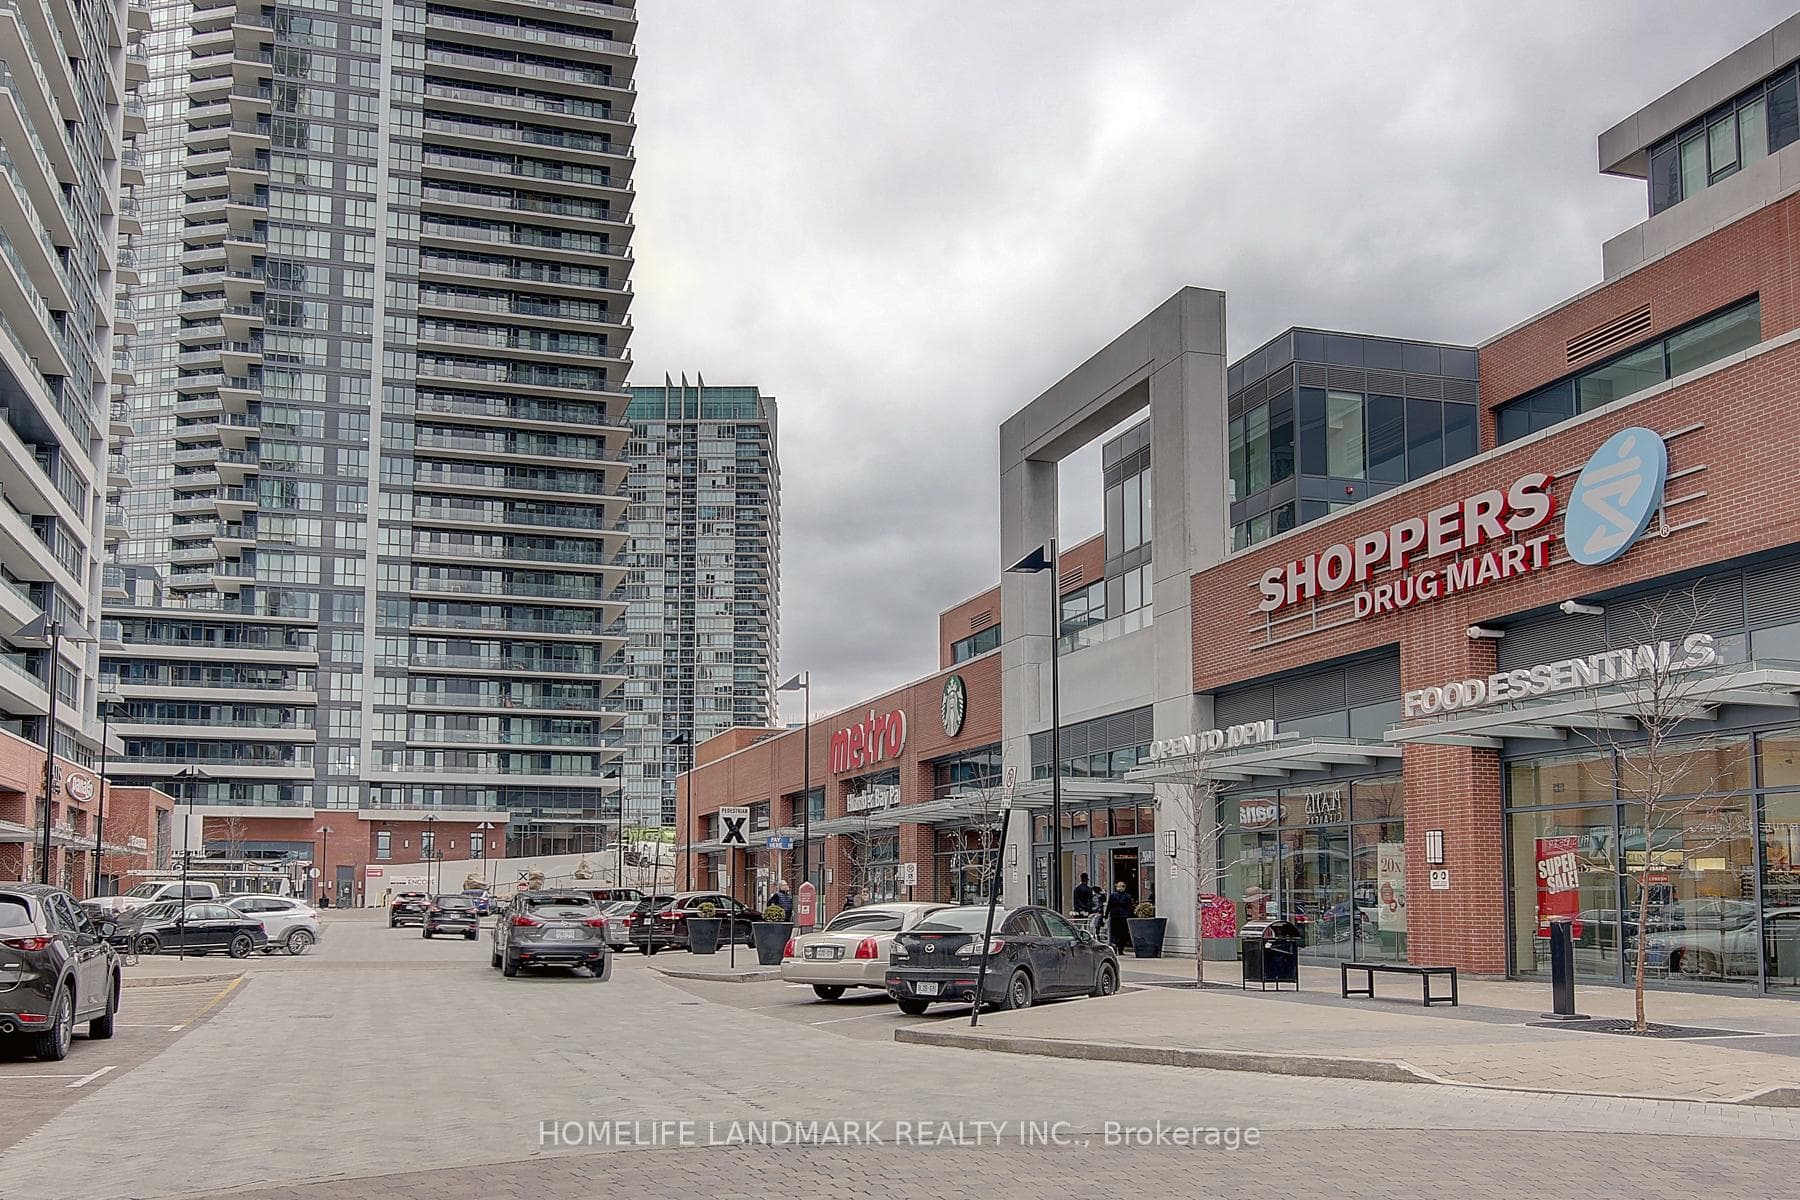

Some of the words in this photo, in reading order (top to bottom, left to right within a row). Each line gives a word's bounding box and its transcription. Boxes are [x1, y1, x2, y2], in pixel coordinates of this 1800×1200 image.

[1258, 473, 1556, 612] SHOPPERS
[1354, 570, 1444, 619] DRUG
[1447, 534, 1556, 593] MART
[1405, 679, 1485, 717] FOOD
[1488, 633, 1717, 701] ESSENTIALS
[829, 709, 907, 774] metro
[1150, 734, 1196, 760] OPEN
[1199, 729, 1224, 753] TO
[1226, 719, 1274, 748] 10PM
[721, 817, 747, 844] X
[1380, 858, 1402, 873] 20x
[1538, 852, 1577, 879] SUPER
[1547, 869, 1579, 894] SALE!
